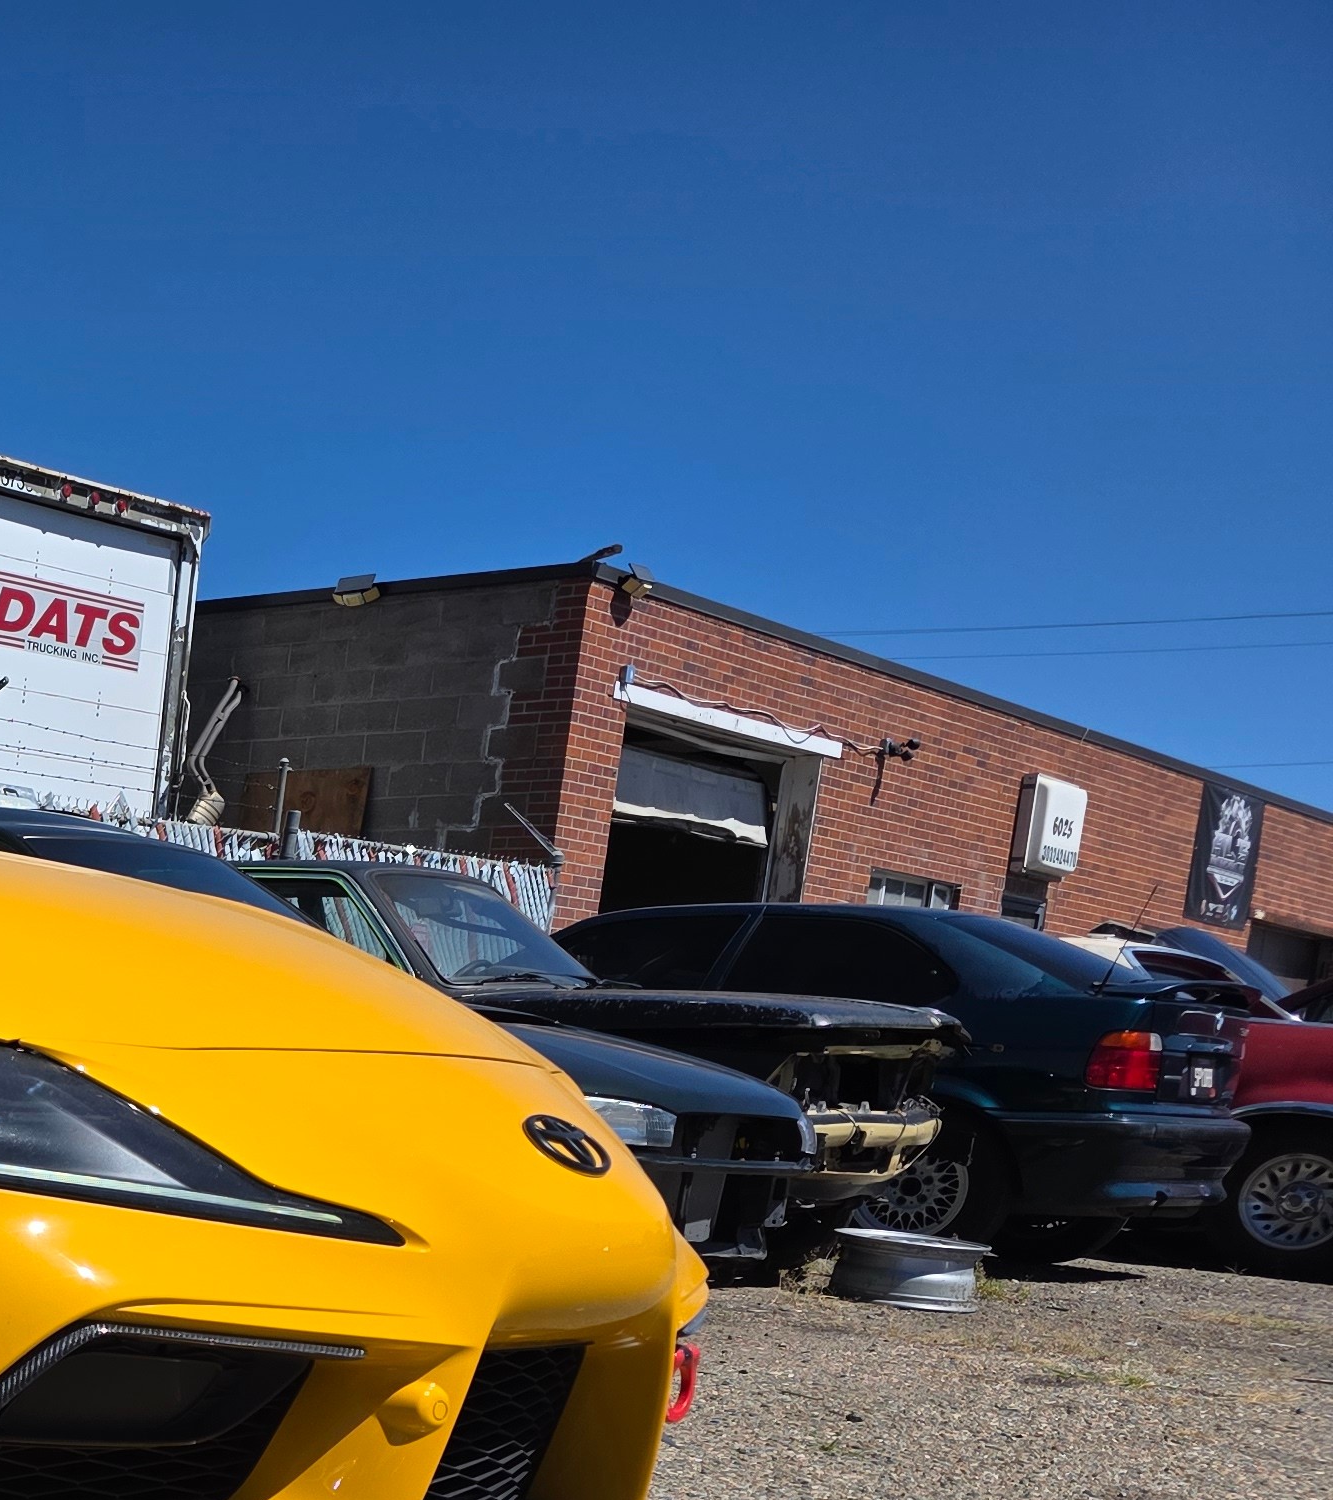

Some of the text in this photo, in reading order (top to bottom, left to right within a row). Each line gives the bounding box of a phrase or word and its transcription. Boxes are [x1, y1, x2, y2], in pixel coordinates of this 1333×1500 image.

[26, 639, 102, 665] TRUCKING INC.
[1052, 816, 1074, 840] 6025
